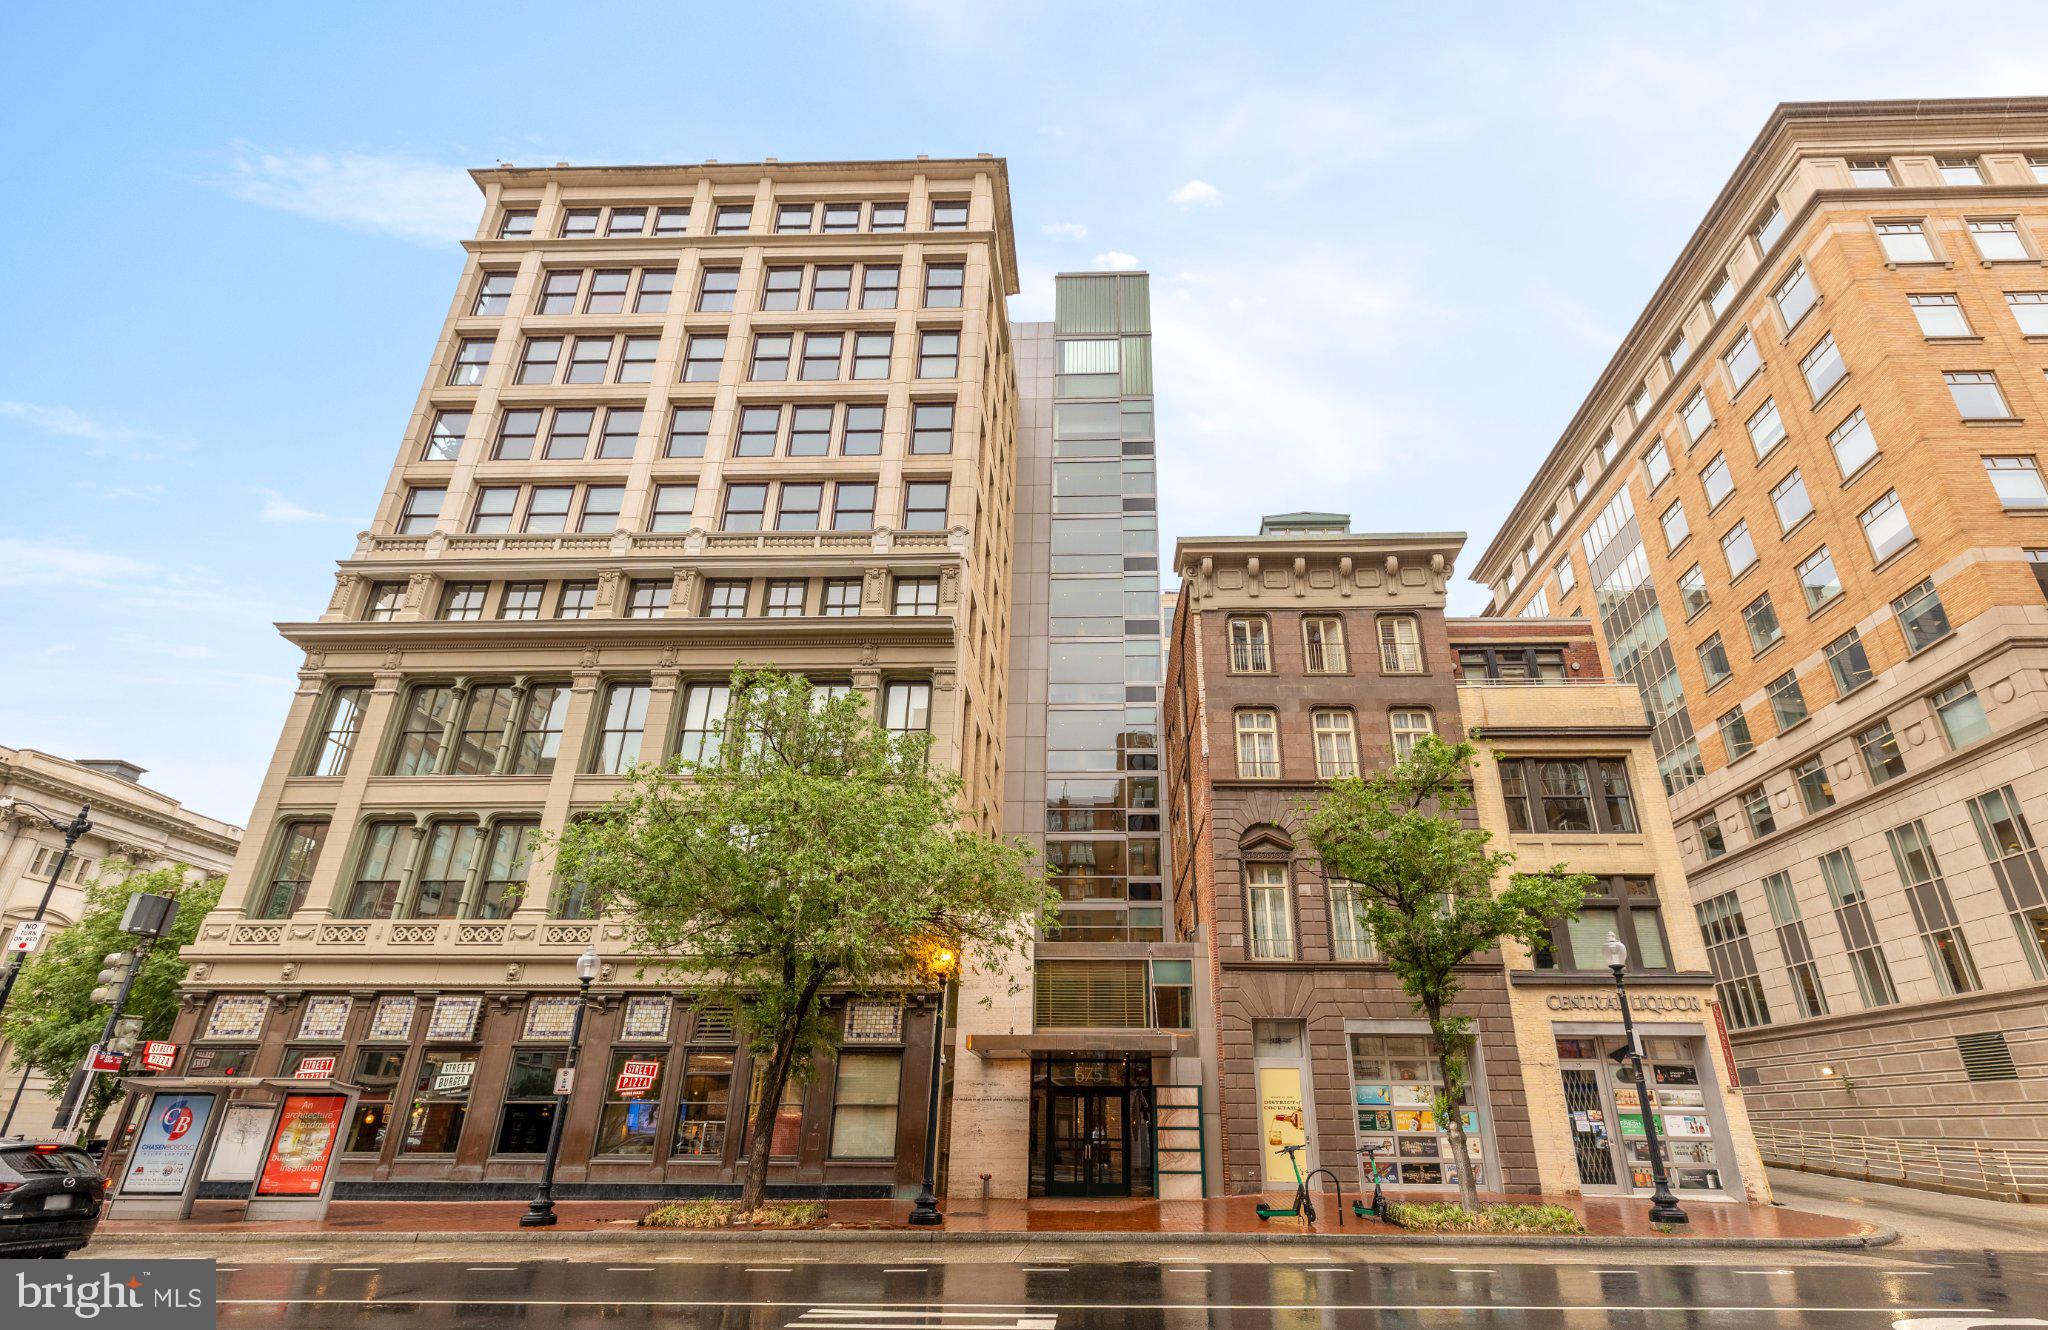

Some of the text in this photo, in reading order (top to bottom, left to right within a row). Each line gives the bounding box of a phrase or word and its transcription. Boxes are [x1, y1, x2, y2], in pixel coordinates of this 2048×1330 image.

[1630, 994, 1702, 1014] LIQUOR
[1713, 1005, 1727, 1047] CENTRAL
[152, 1044, 173, 1053] STREET
[150, 1055, 171, 1068] PIZZA
[304, 1060, 331, 1070] STREET
[444, 1063, 472, 1073] STREET
[628, 1064, 654, 1075] STREET
[1074, 1067, 1103, 1082] 675
[438, 1076, 466, 1088] BURGER
[622, 1077, 648, 1087] PIZZA
[301, 1101, 314, 1109] An
[285, 1110, 333, 1119] architecture
[298, 1121, 336, 1129] landmark
[271, 1153, 326, 1162] built for
[280, 1164, 323, 1173] inspiration
